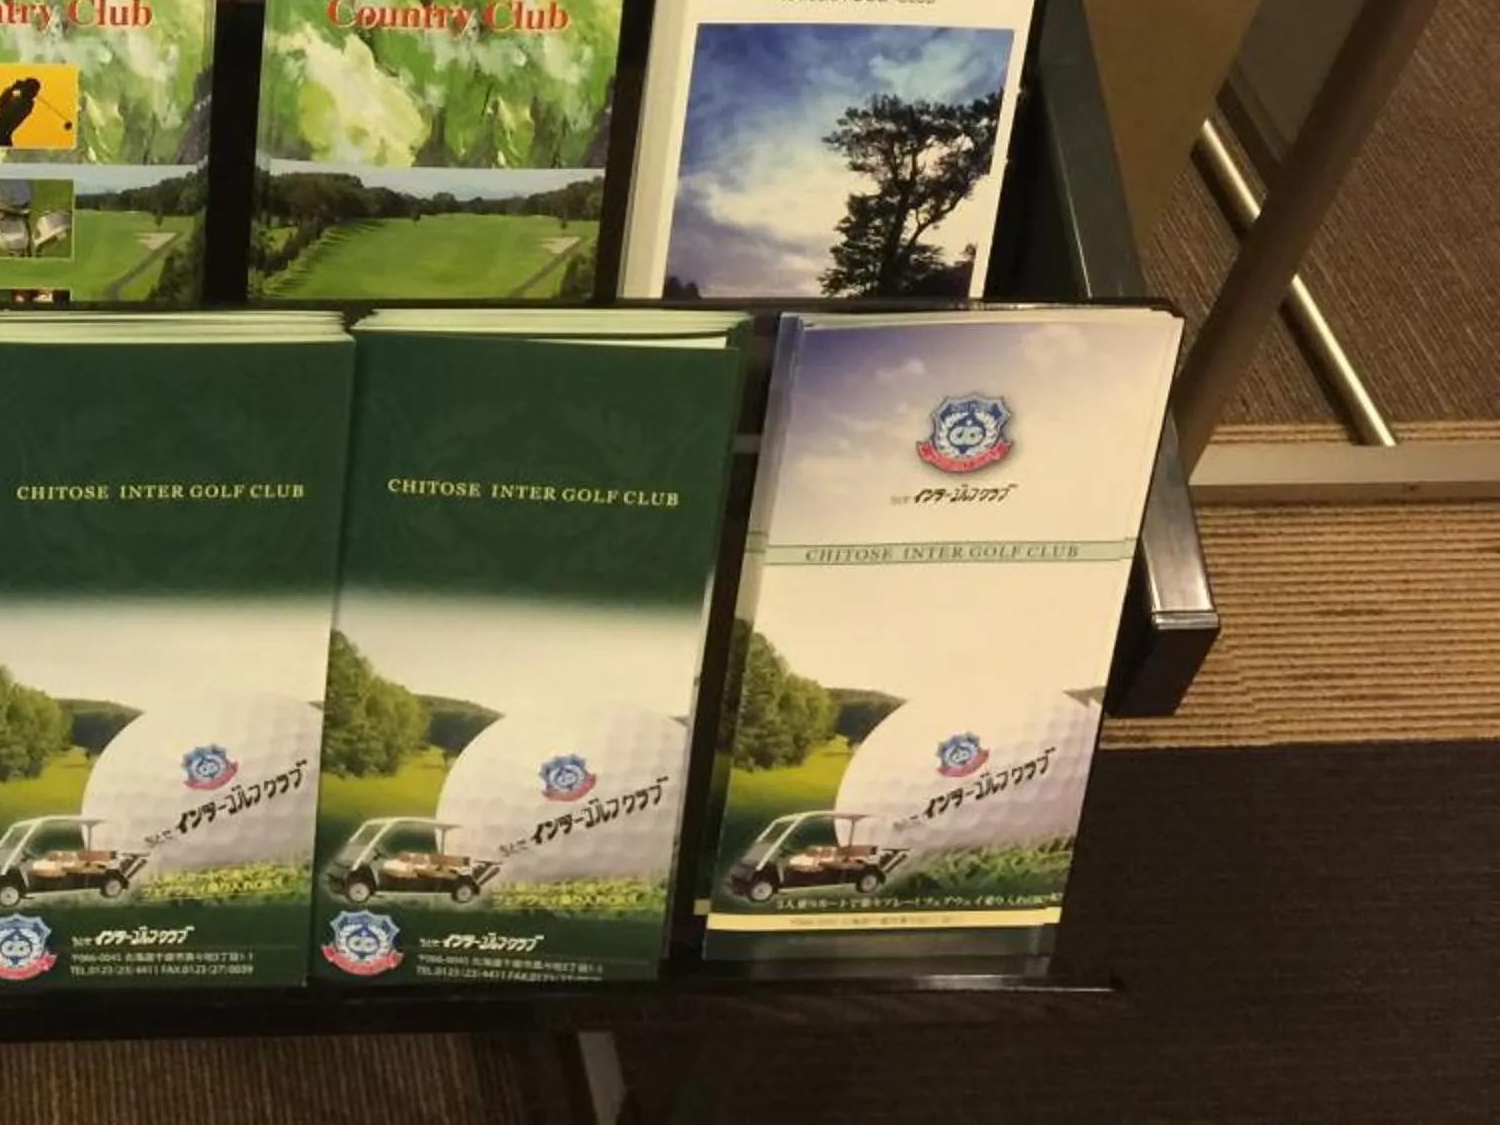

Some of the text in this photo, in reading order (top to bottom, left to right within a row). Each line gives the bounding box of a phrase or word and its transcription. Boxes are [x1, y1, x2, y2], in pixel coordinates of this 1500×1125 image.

[16, 484, 305, 500] CHITOSE INTER GOLF CLUB
[387, 478, 680, 507] CHITOSE INTER GOLF CLUB
[805, 544, 1080, 563] CHITOSE INTER GOLF CLUB
